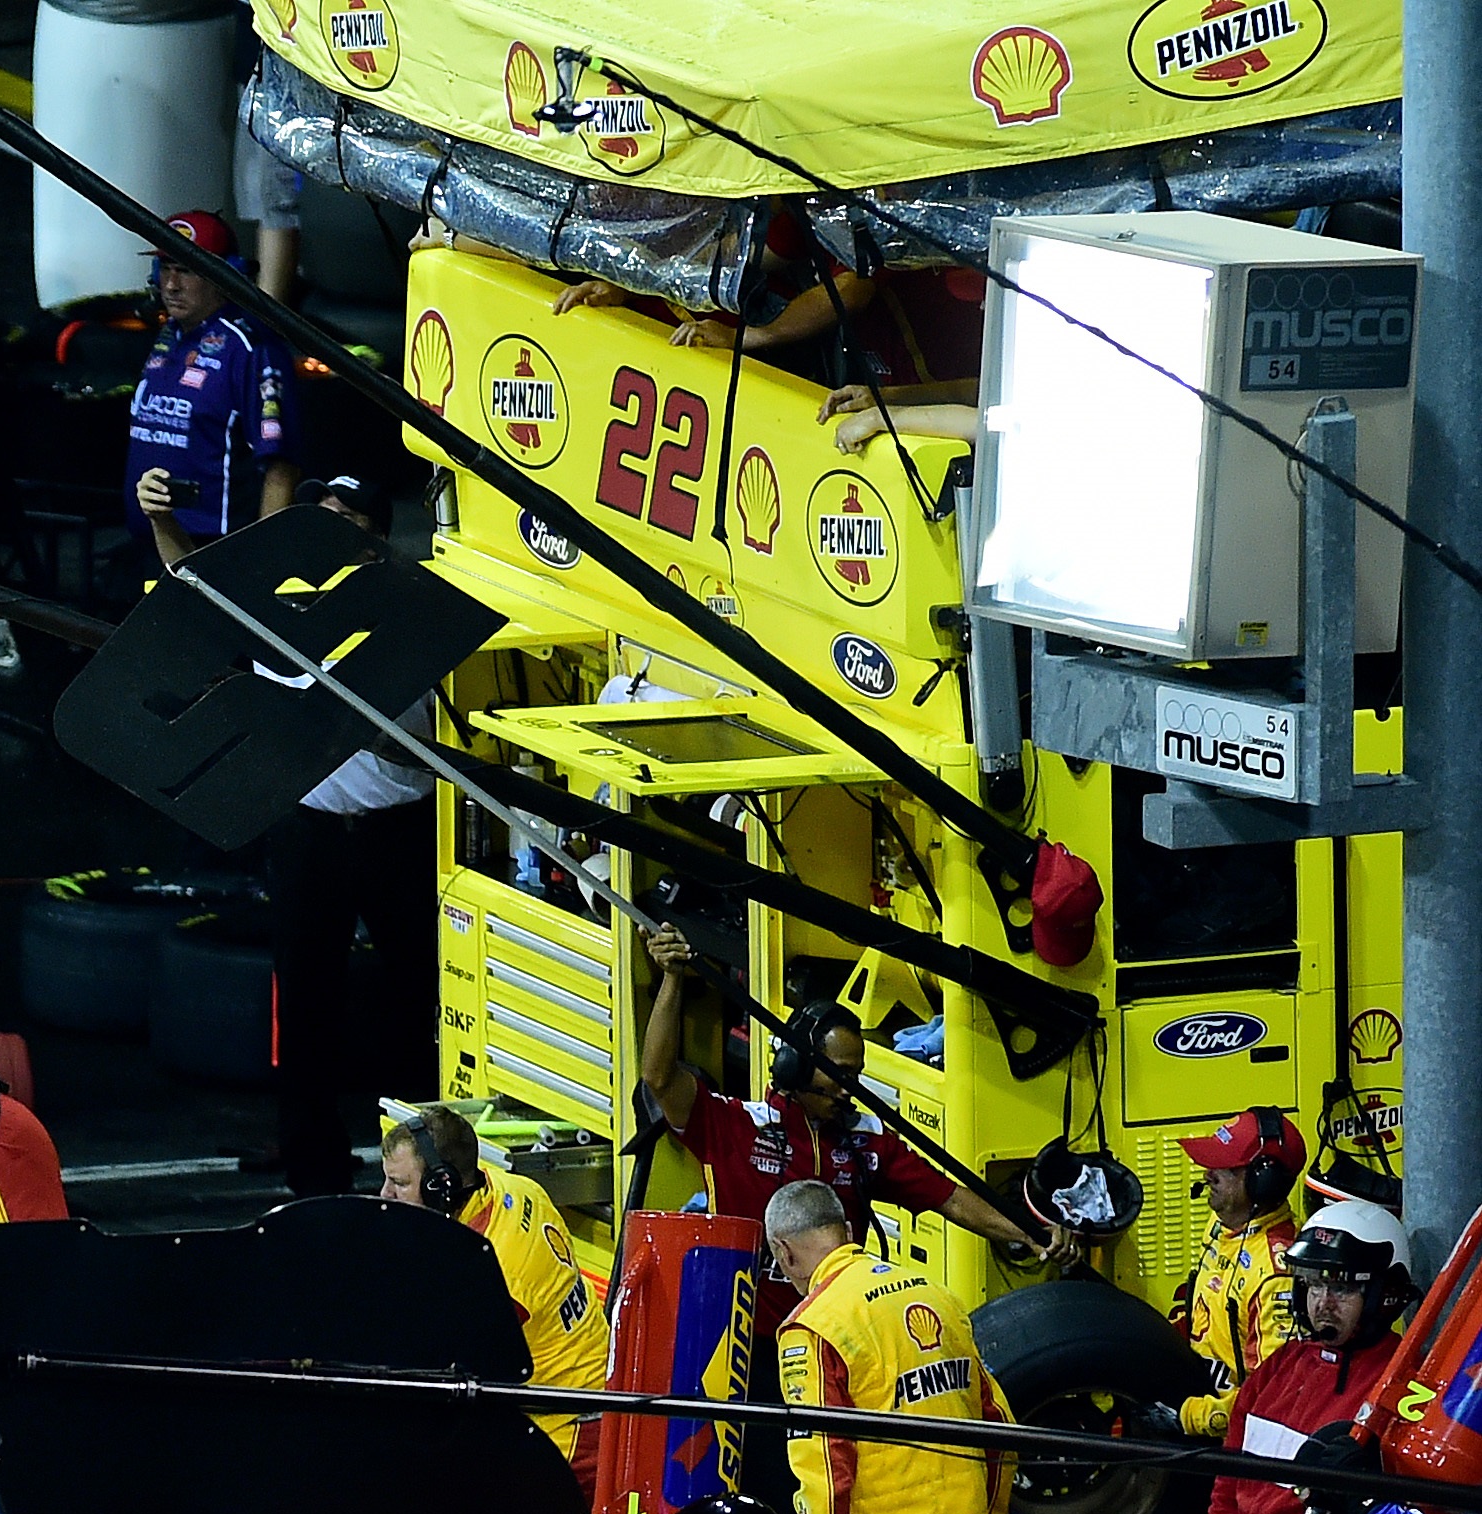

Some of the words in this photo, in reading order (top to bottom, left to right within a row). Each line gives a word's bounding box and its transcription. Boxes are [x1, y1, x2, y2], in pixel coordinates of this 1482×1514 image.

[331, 12, 389, 49] PENNZOIL
[1157, 2, 1297, 75] PENNZOIL
[584, 97, 654, 133] PENNZOIL
[1245, 308, 1412, 348] MUSCO
[141, 393, 193, 418] JACOB
[490, 380, 557, 420] PENNZOIL
[596, 366, 709, 541] 22
[819, 516, 885, 557] PENNZOIL
[842, 643, 885, 690] Ford
[1164, 730, 1285, 780] MUSCO
[443, 960, 475, 982] Snap-on
[444, 1005, 475, 1033] SKF
[1176, 1018, 1243, 1052] Ford
[908, 1102, 941, 1131] Mazak
[865, 1277, 929, 1303] WILLIAMS
[894, 1359, 971, 1411] PENNOIL
